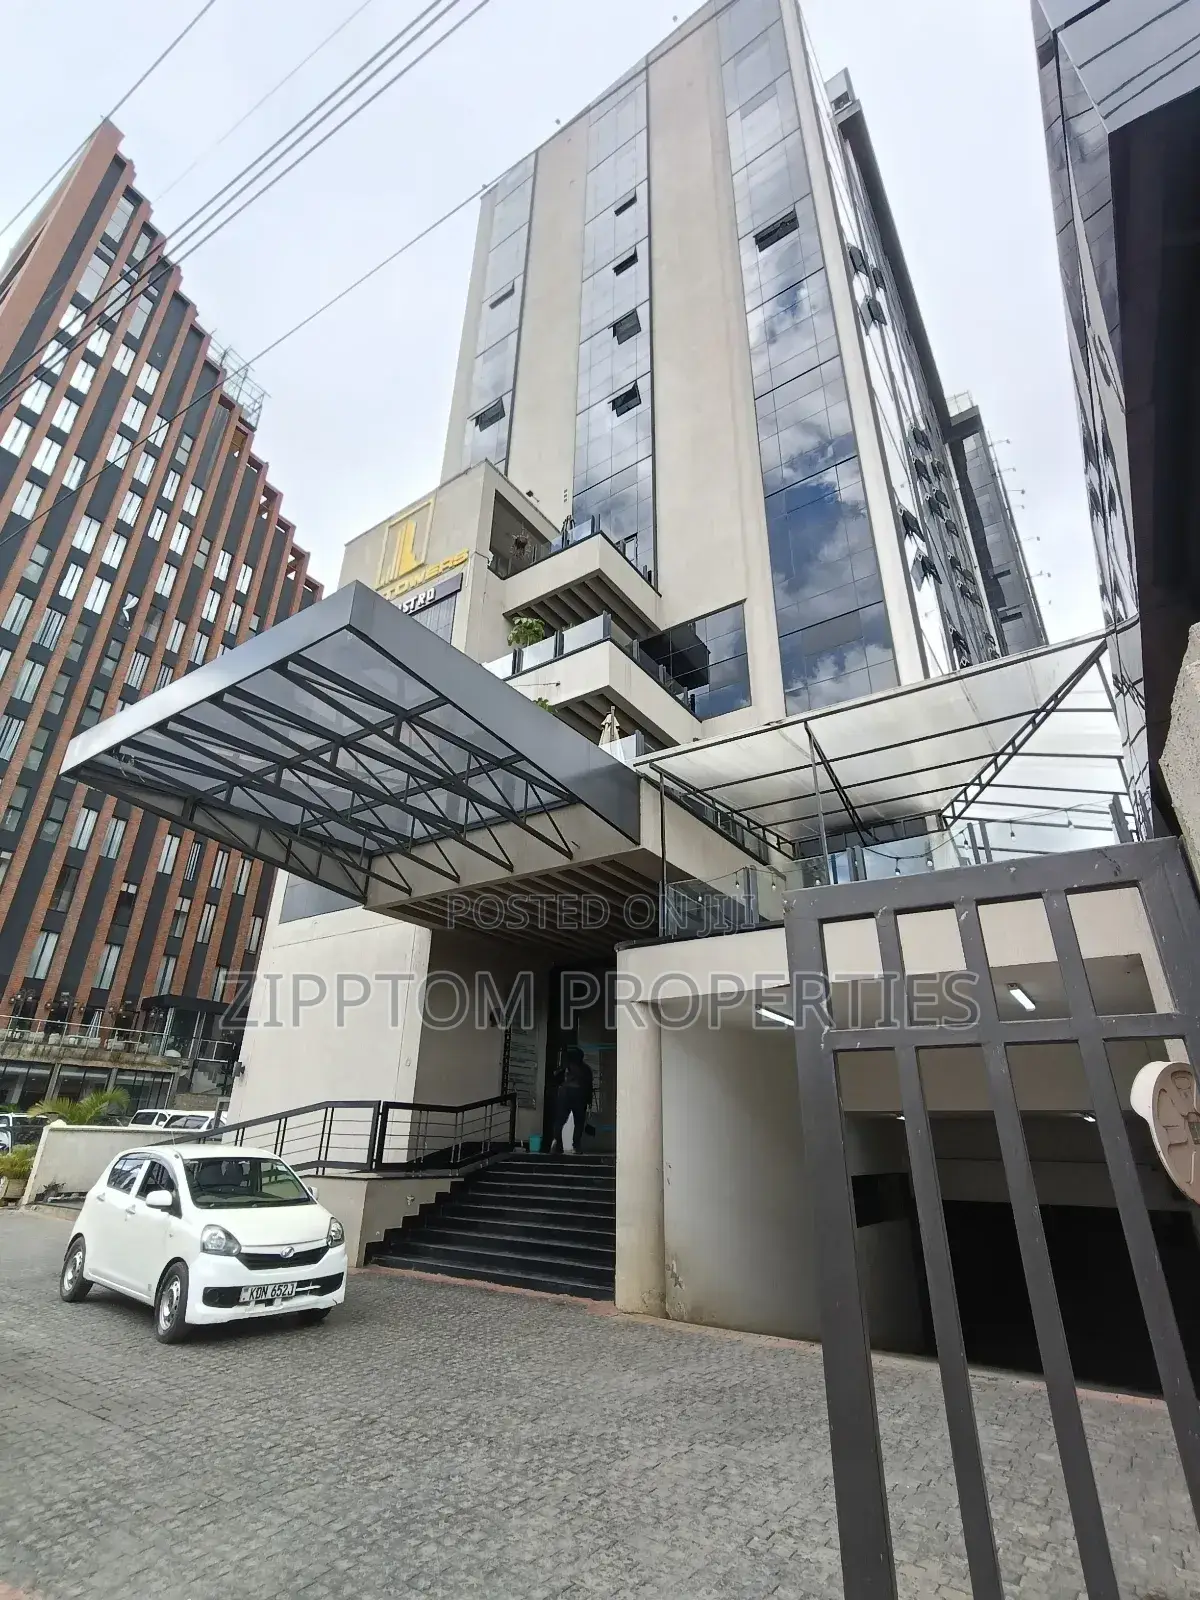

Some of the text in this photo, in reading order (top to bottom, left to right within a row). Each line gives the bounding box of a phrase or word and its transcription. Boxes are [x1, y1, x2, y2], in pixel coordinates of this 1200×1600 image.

[383, 548, 469, 600] TOWERS
[249, 1283, 295, 1300] KDN 652J
